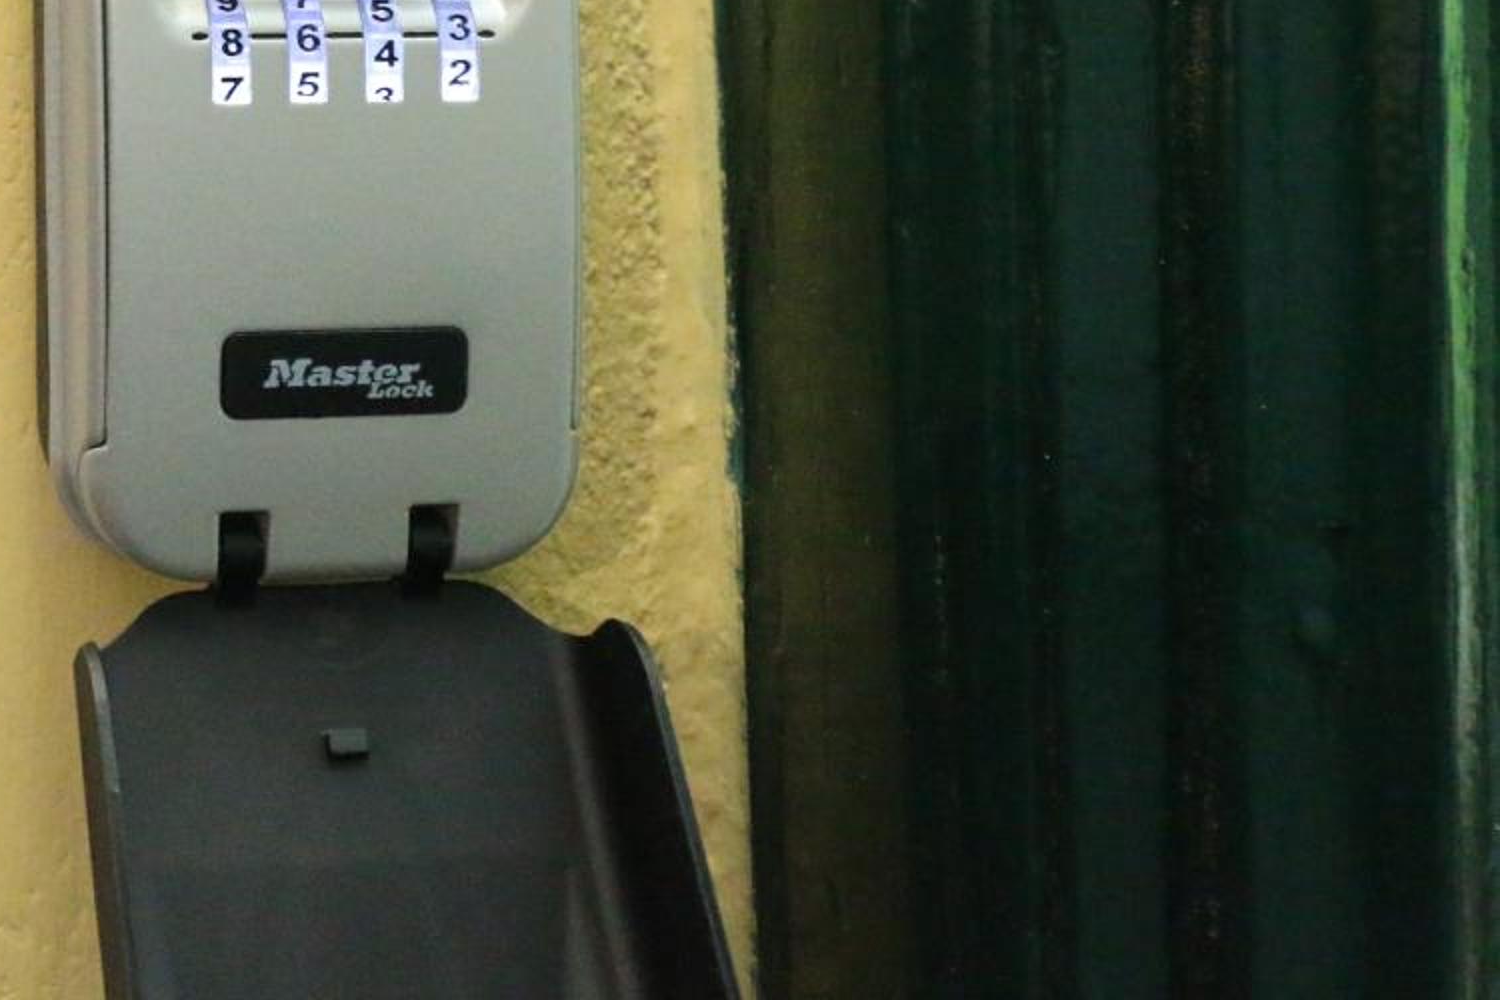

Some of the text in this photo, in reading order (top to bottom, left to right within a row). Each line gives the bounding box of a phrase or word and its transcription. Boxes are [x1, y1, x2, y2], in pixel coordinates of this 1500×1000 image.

[371, 0, 394, 22] 5
[222, 14, 471, 67] 8 6 4 3
[221, 77, 244, 101] 7
[297, 72, 320, 97] 5
[450, 59, 472, 86] 2
[263, 357, 421, 388] Master
[366, 379, 434, 399] Lock
